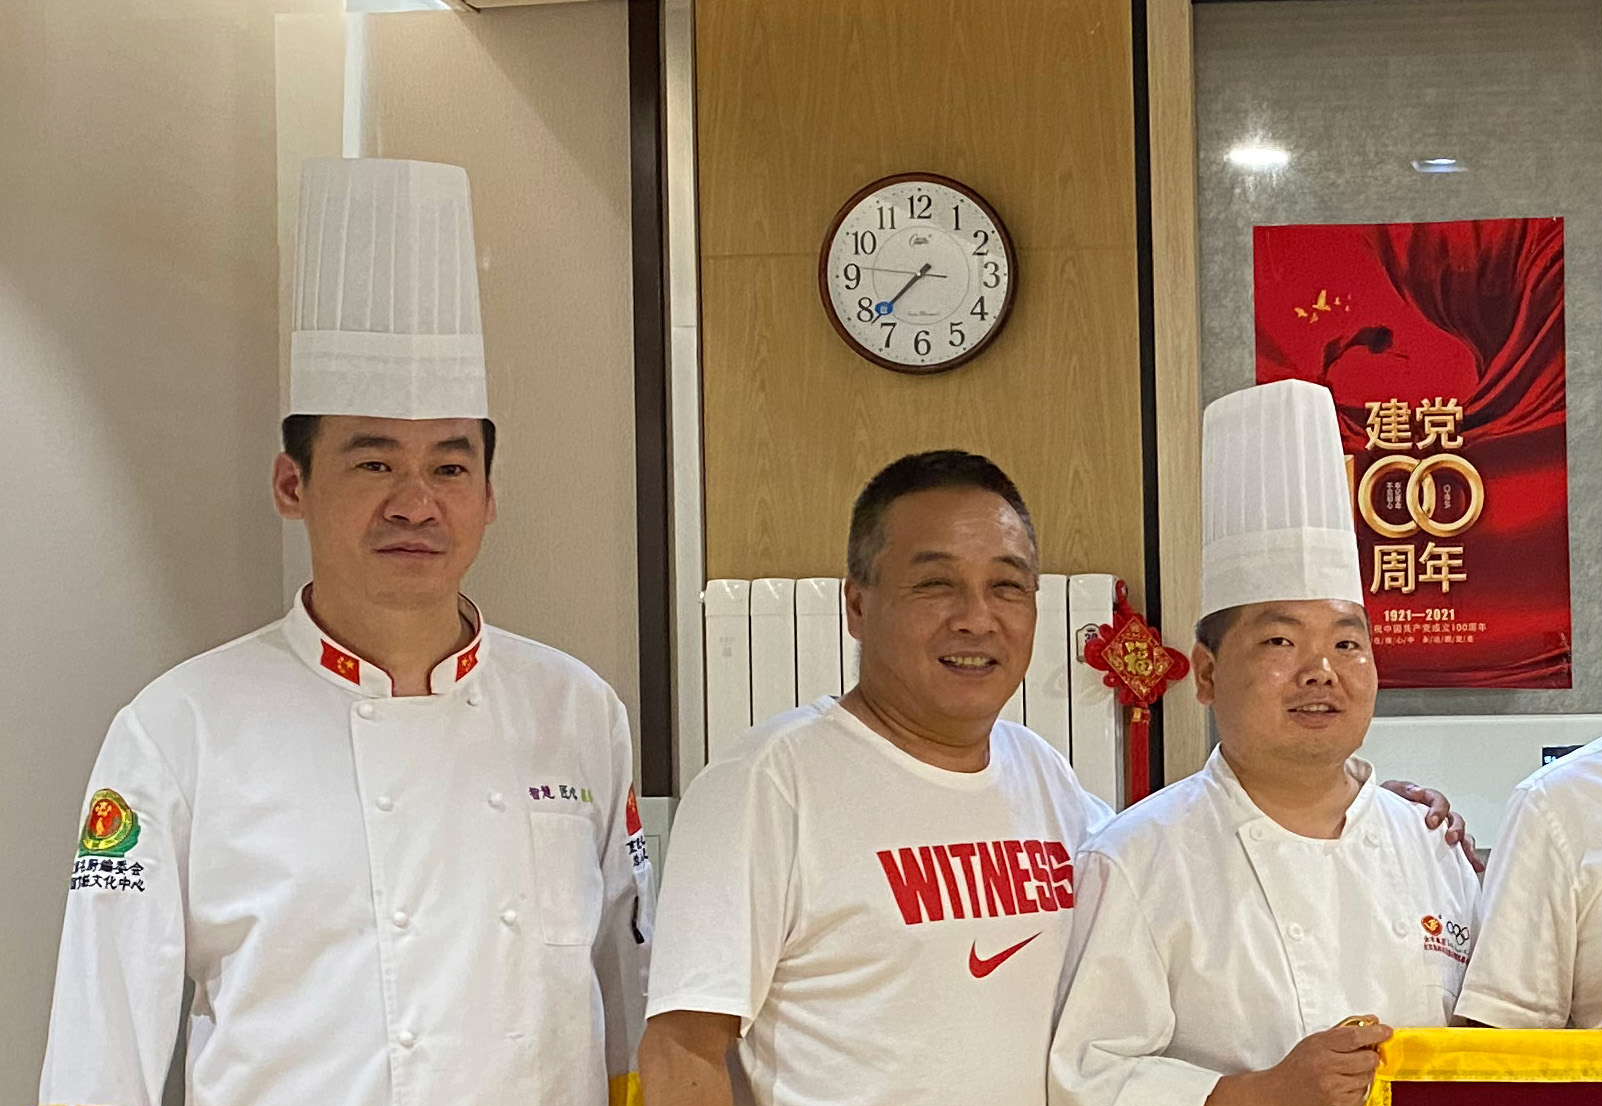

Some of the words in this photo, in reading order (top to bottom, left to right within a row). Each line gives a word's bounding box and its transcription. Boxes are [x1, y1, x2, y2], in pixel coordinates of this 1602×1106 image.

[877, 205, 896, 230] 11
[907, 194, 932, 220] 12
[952, 204, 962, 231] 1
[852, 230, 877, 256] 10
[972, 229, 989, 256] 2
[843, 263, 861, 290] 9
[982, 261, 1000, 289] 3
[856, 296, 874, 323] 8
[969, 295, 989, 321] 4
[880, 322, 896, 348] 7
[913, 329, 931, 356] 6
[948, 321, 966, 348] 5
[1364, 396, 1464, 450] 建党
[1370, 542, 1467, 594] 周年
[876, 839, 1074, 925] WITNESS
